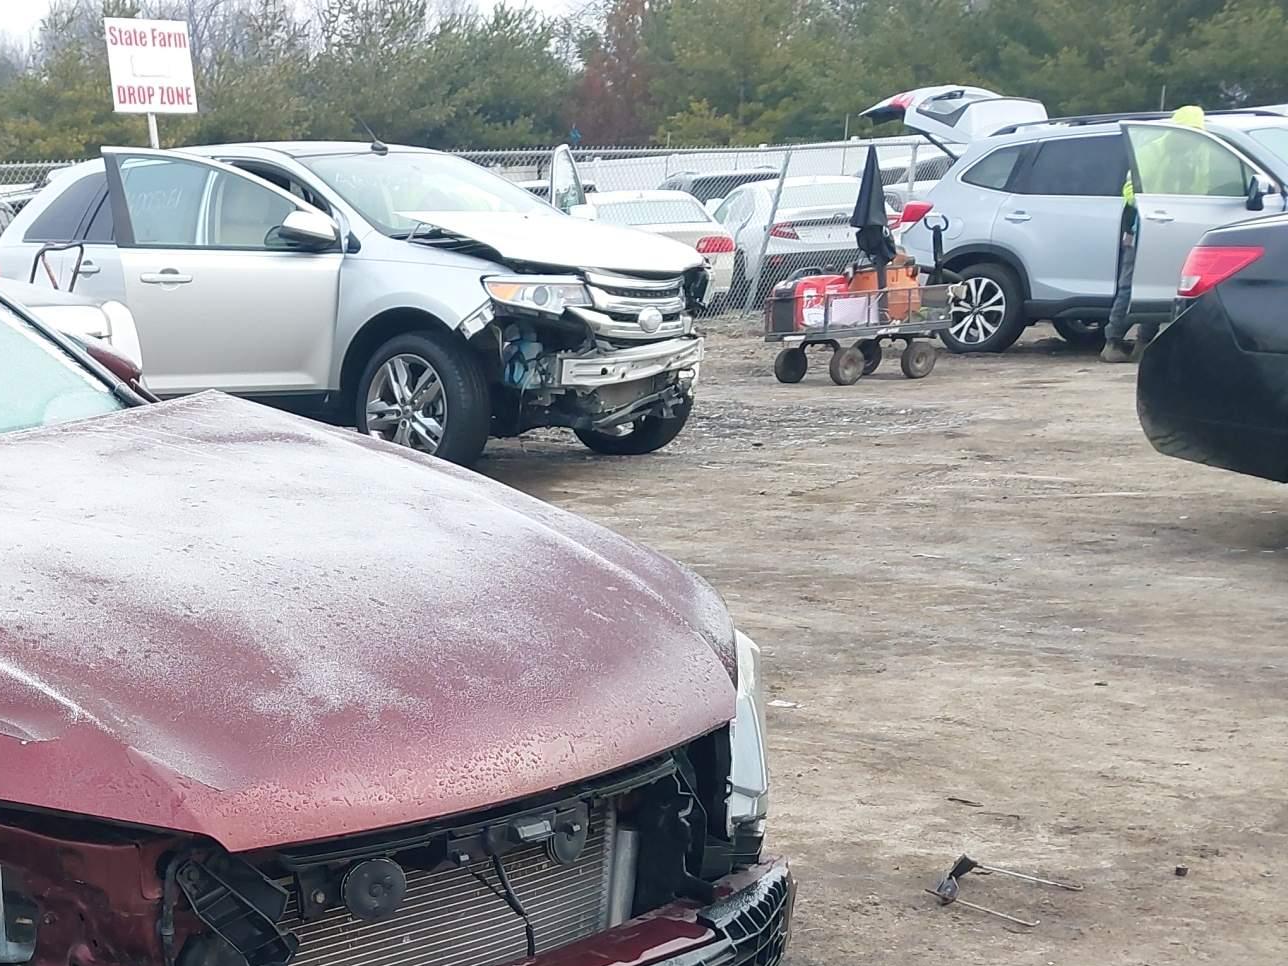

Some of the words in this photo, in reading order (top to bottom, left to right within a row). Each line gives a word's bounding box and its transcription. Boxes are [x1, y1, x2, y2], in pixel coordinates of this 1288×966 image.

[108, 26, 148, 47] State
[150, 28, 187, 49] Farm
[117, 85, 155, 105] DROP
[158, 86, 193, 106] ZONE
